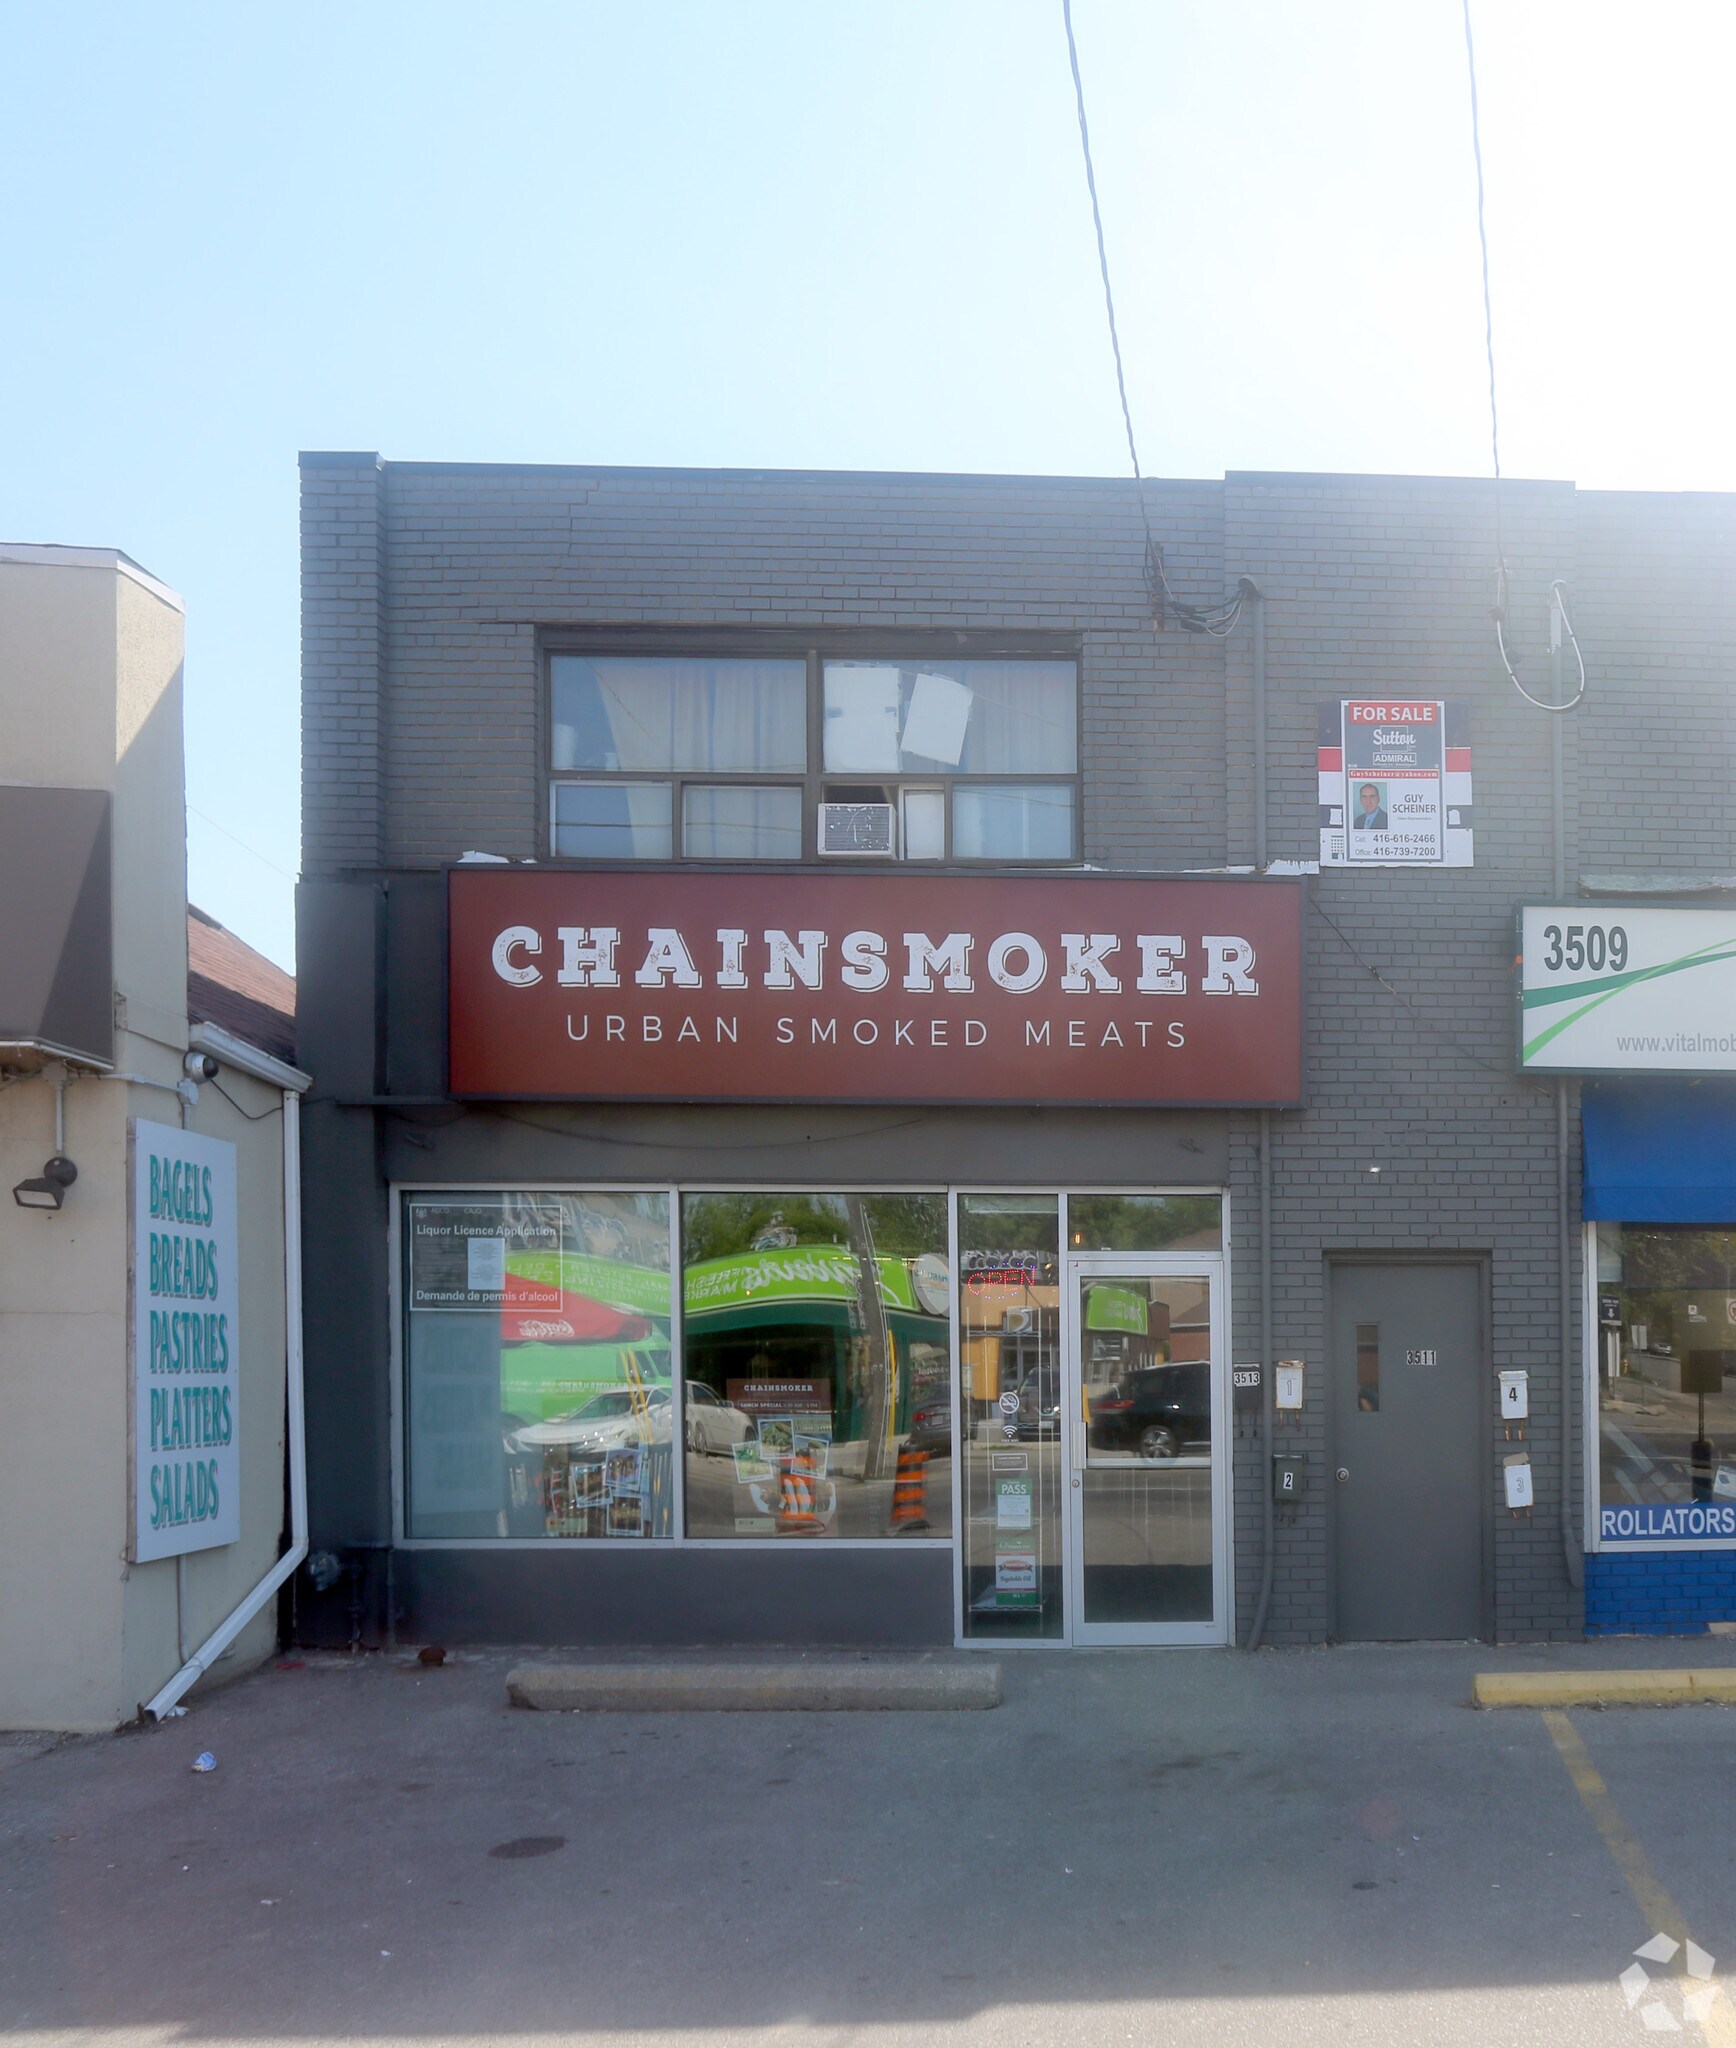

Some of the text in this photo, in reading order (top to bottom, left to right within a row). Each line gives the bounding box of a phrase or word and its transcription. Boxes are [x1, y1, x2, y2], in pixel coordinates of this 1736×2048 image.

[1353, 706, 1432, 721] FOR SALE
[1373, 728, 1417, 745] Sutton
[1374, 754, 1415, 763] ADMIRAL
[1404, 794, 1424, 803] GUY
[1392, 804, 1436, 814] SCHEINER
[1373, 834, 1435, 843] 416-616-2466
[1373, 847, 1435, 856] 416-739-7200
[1543, 925, 1629, 972] 3509
[491, 924, 1260, 997] CHAINSMOKER
[565, 1014, 1188, 1049] URBAN SMOKED MEATS
[149, 1153, 213, 1228] BAGELS
[416, 1225, 556, 1237] Liquor Licence Application
[149, 1231, 219, 1301] BREADS
[968, 1269, 1036, 1294] OPEN
[416, 1290, 558, 1303] Demande de permis d'alcool
[149, 1309, 229, 1375] PASTRIES
[1406, 1350, 1437, 1365] 3511
[1234, 1371, 1260, 1385] 3513
[744, 1384, 813, 1392] CHAINSMOKER
[1286, 1379, 1293, 1396] 1
[1508, 1387, 1518, 1402] 4
[149, 1385, 232, 1453] PLATTERS
[1284, 1473, 1292, 1488] 2
[1515, 1477, 1525, 1494] 3
[149, 1458, 219, 1531] SALADS
[1001, 1484, 1027, 1495] PASS
[1601, 1507, 1736, 1537] ROLLATORS
